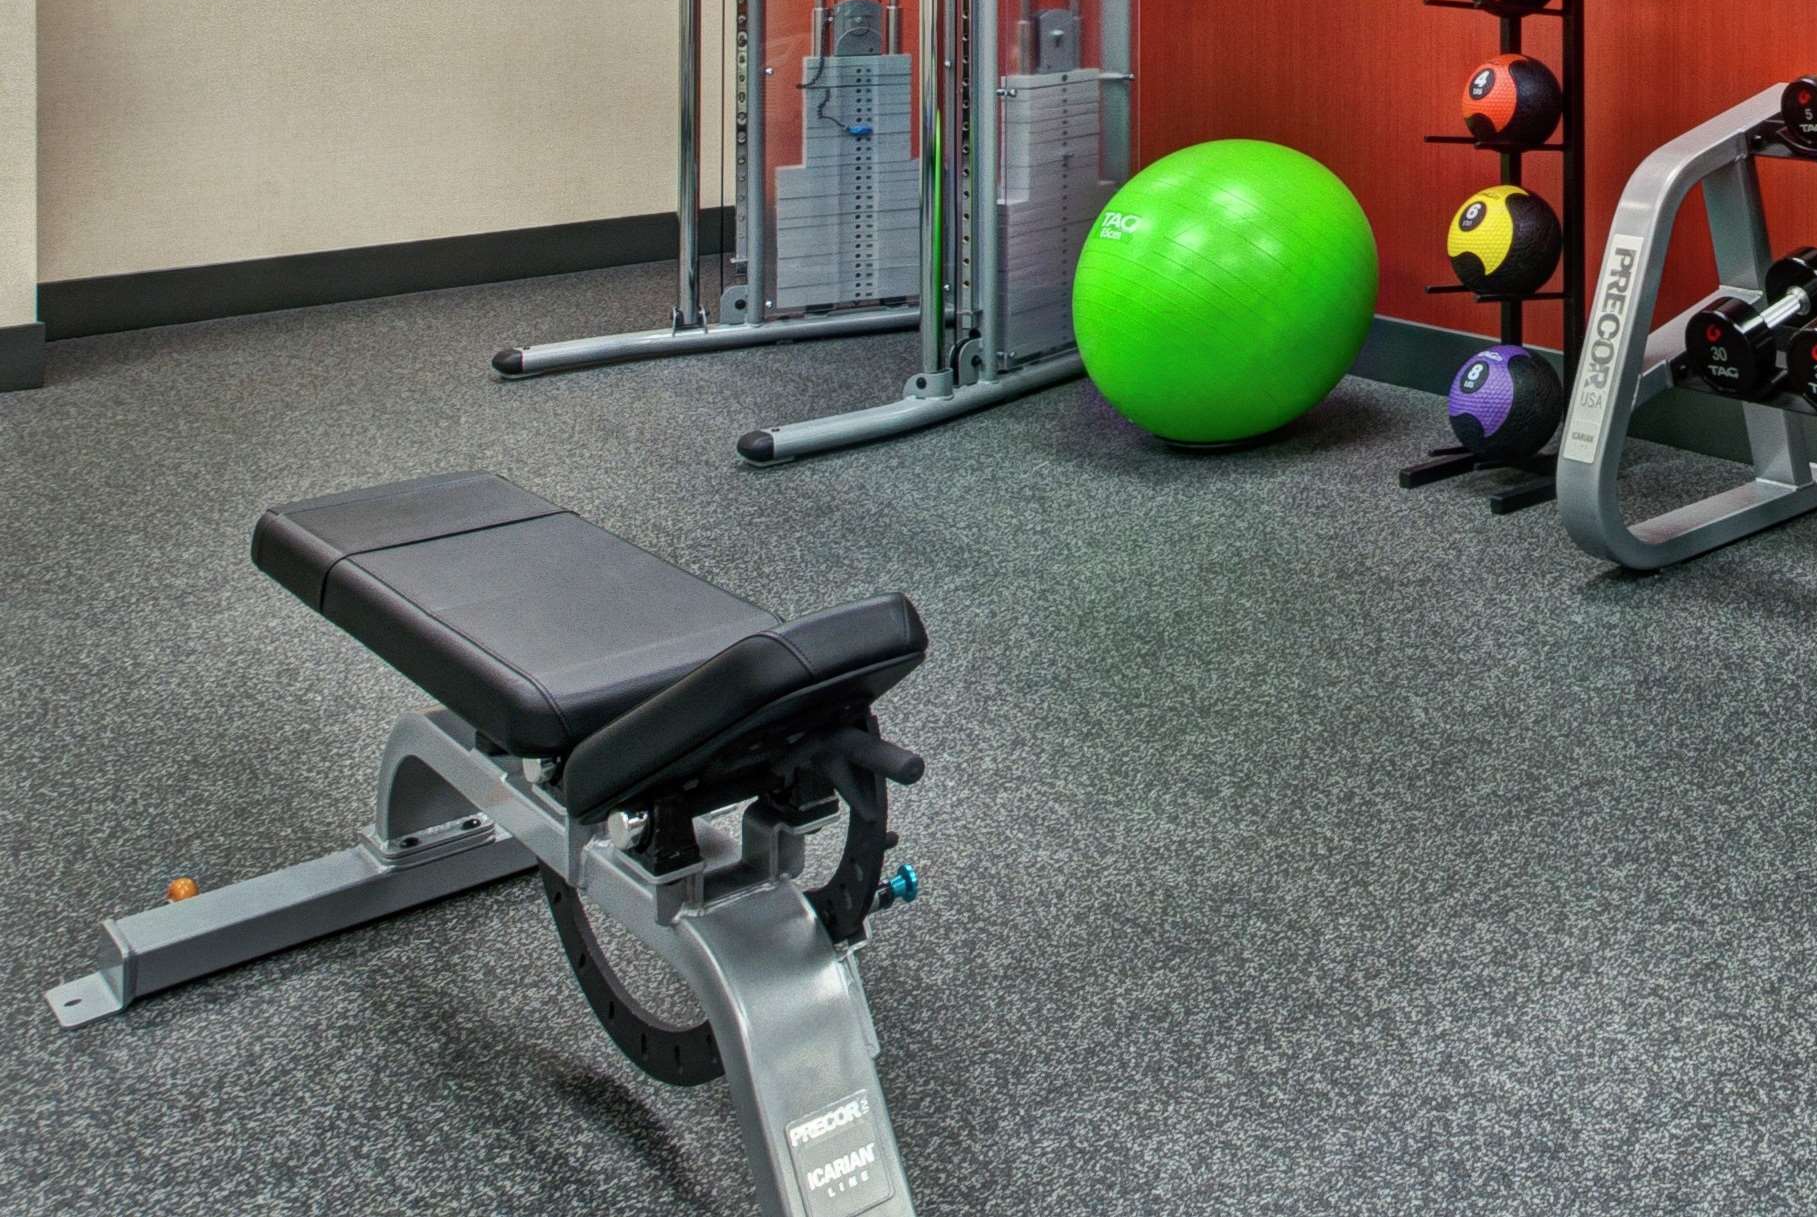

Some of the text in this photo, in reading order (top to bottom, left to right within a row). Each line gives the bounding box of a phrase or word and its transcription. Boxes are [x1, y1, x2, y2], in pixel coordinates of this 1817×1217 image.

[1474, 70, 1490, 87] 4
[1804, 108, 1813, 120] 5
[1466, 203, 1481, 219] 6
[1584, 248, 1637, 390] PRECOR
[1711, 347, 1728, 362] 30
[1468, 364, 1483, 380] 8
[1707, 365, 1739, 379] TAG
[1580, 391, 1603, 408] USA
[789, 1099, 862, 1148] PRECOR
[807, 1143, 875, 1191] ICARIAN
